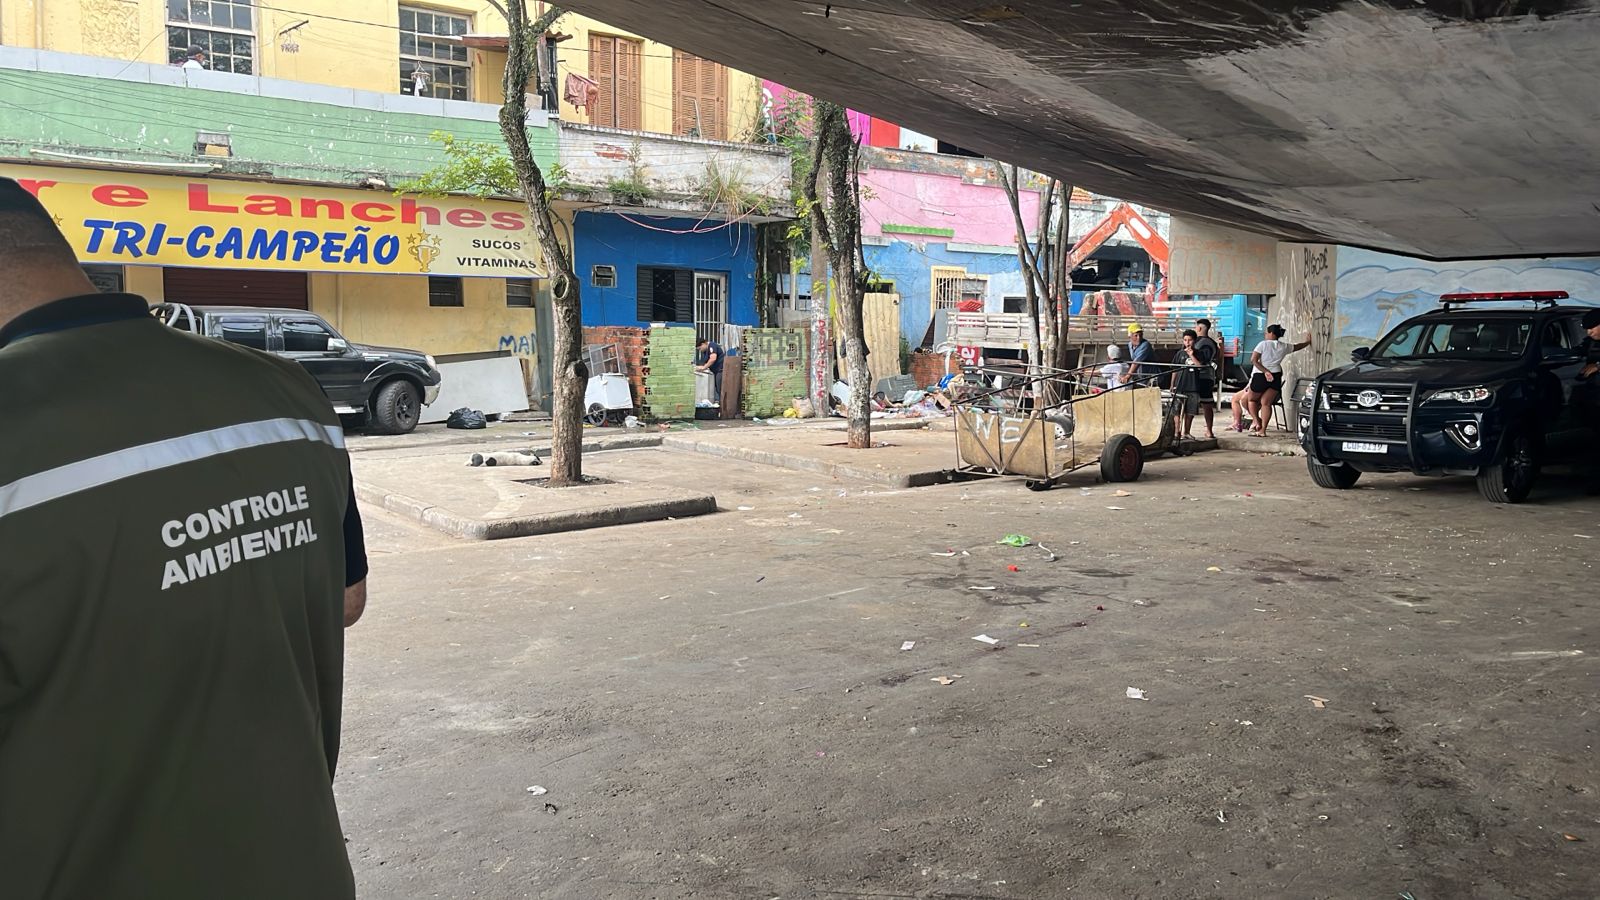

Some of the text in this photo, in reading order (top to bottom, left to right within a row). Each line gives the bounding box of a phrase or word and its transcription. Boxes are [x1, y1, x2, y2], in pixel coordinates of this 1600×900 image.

[91, 184, 149, 208] e
[187, 182, 525, 231] Lanches
[82, 218, 401, 266] TRI-CAMPEÃO
[456, 256, 537, 270] VITAMINAS
[472, 239, 521, 251] SUCOS
[160, 485, 310, 549] CONTROLE
[160, 517, 318, 591] AMBIENTAL
